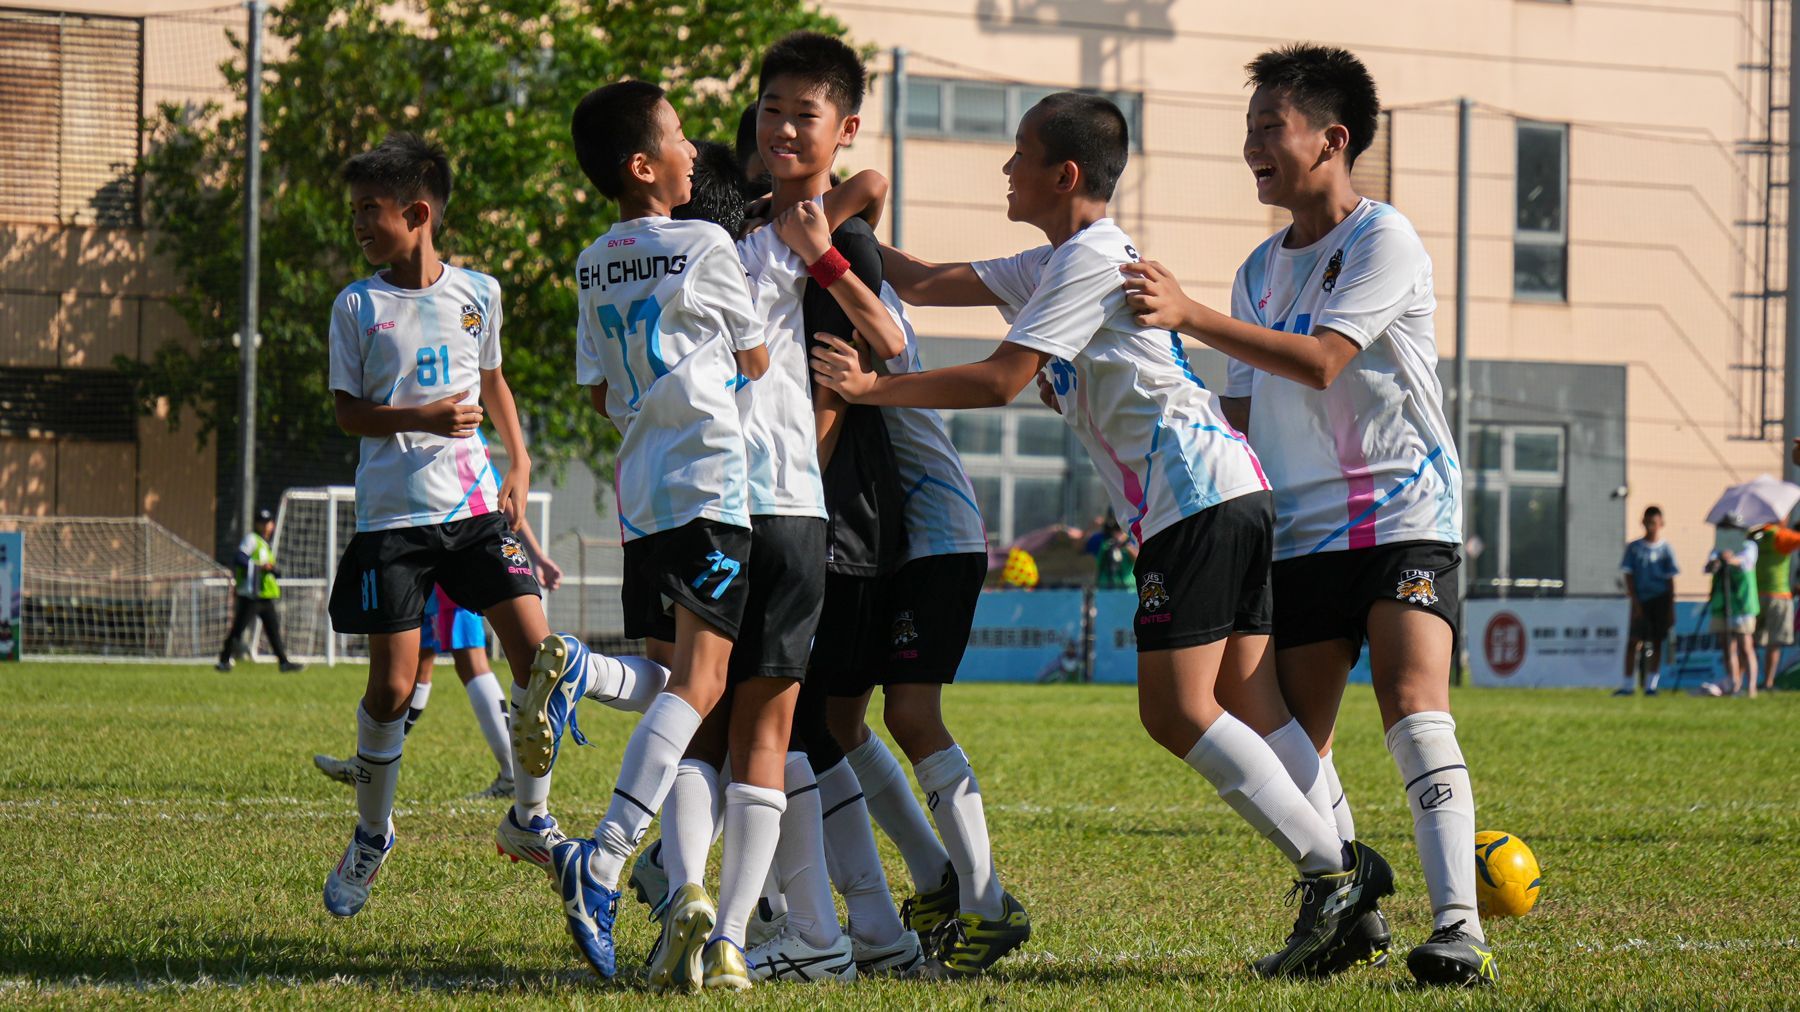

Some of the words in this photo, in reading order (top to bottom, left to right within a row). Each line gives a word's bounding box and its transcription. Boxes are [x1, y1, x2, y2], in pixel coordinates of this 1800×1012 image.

[607, 237, 636, 248] ENTES
[416, 344, 451, 387] 81
[361, 568, 378, 612] 81
[692, 550, 741, 600] 77
